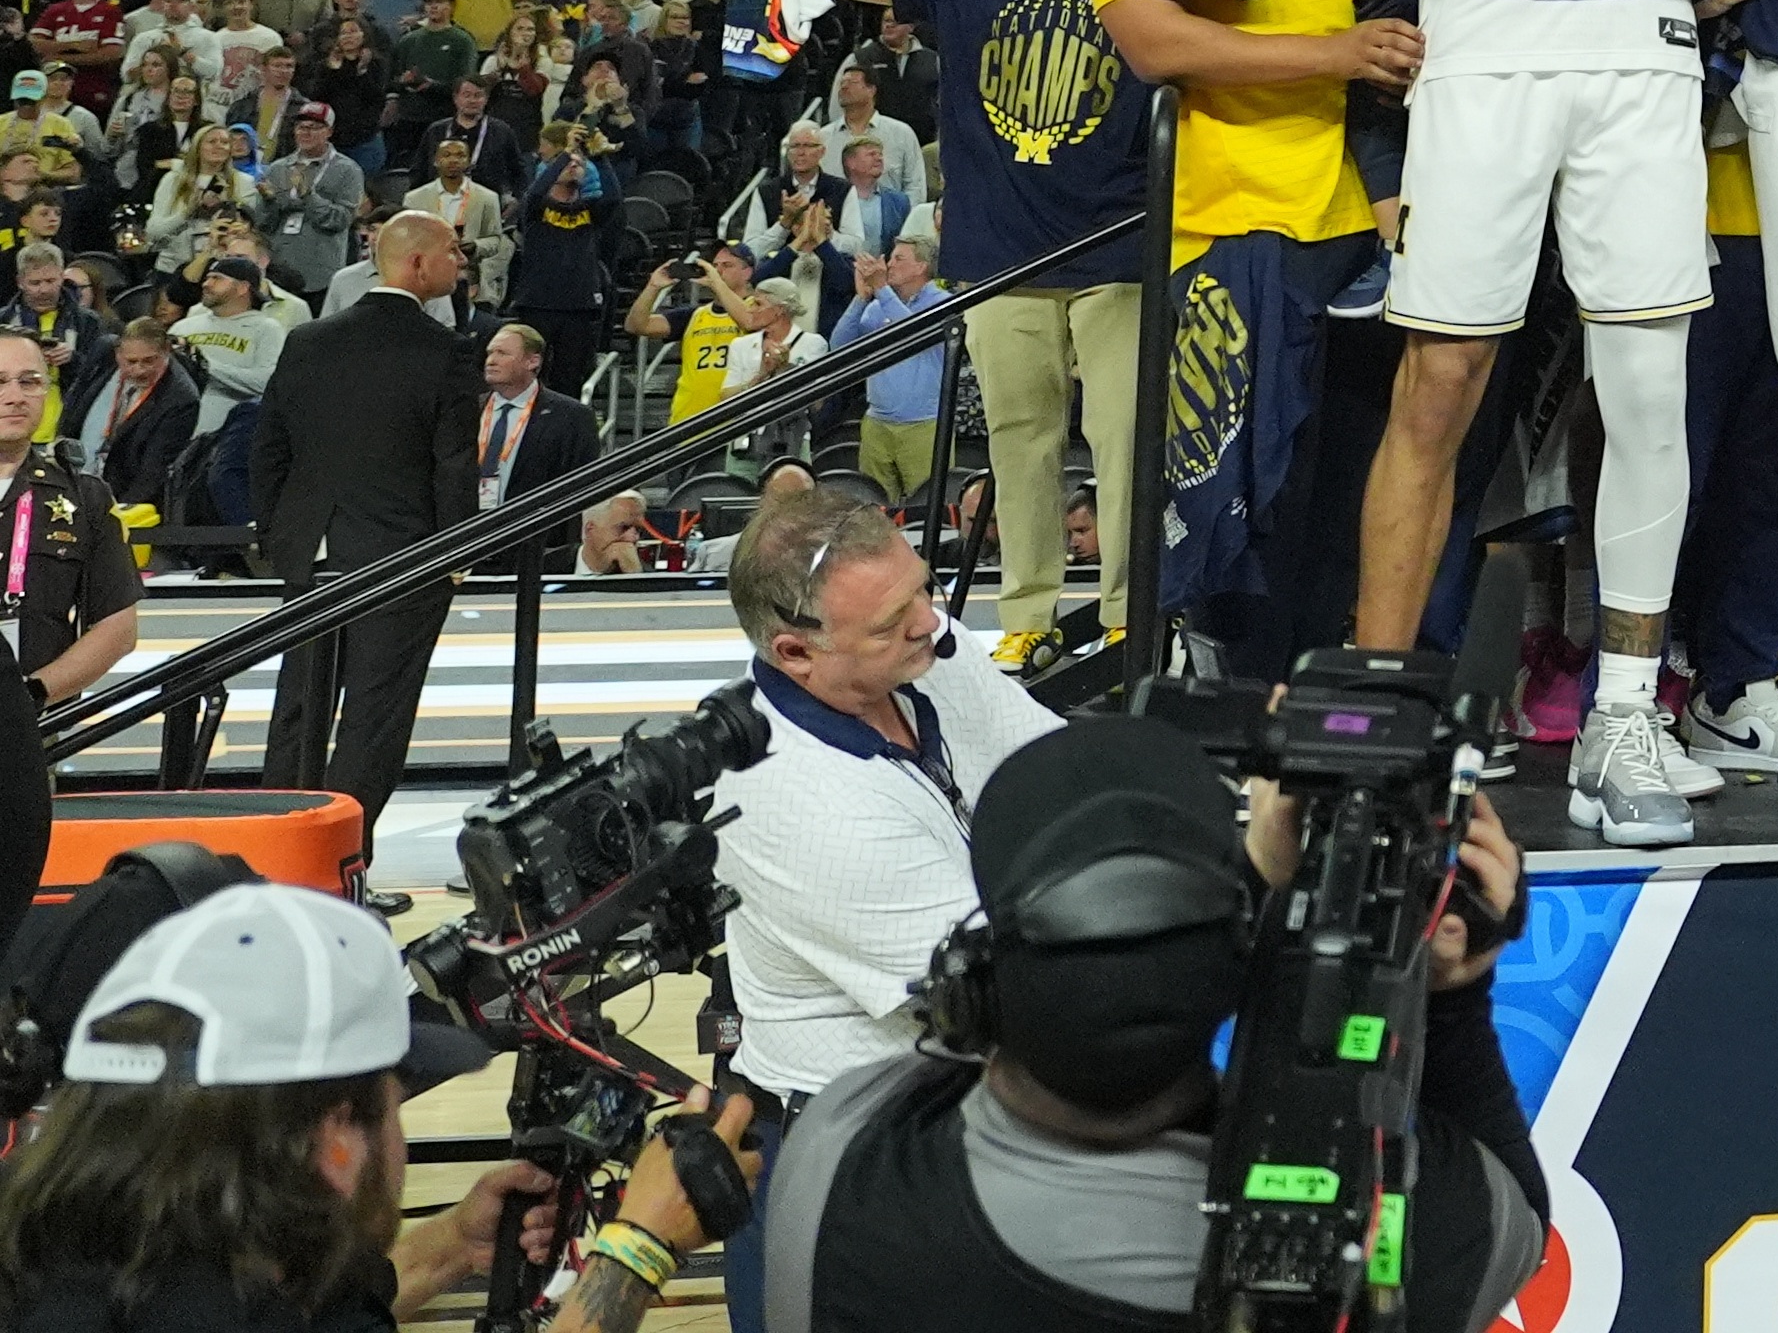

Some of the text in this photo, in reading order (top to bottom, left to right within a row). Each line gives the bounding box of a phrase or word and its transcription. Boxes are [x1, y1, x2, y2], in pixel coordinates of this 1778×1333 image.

[978, 26, 1121, 128] CHAMPS
[1014, 131, 1053, 165] M
[697, 345, 729, 370] 23
[507, 928, 582, 975] RONIN
